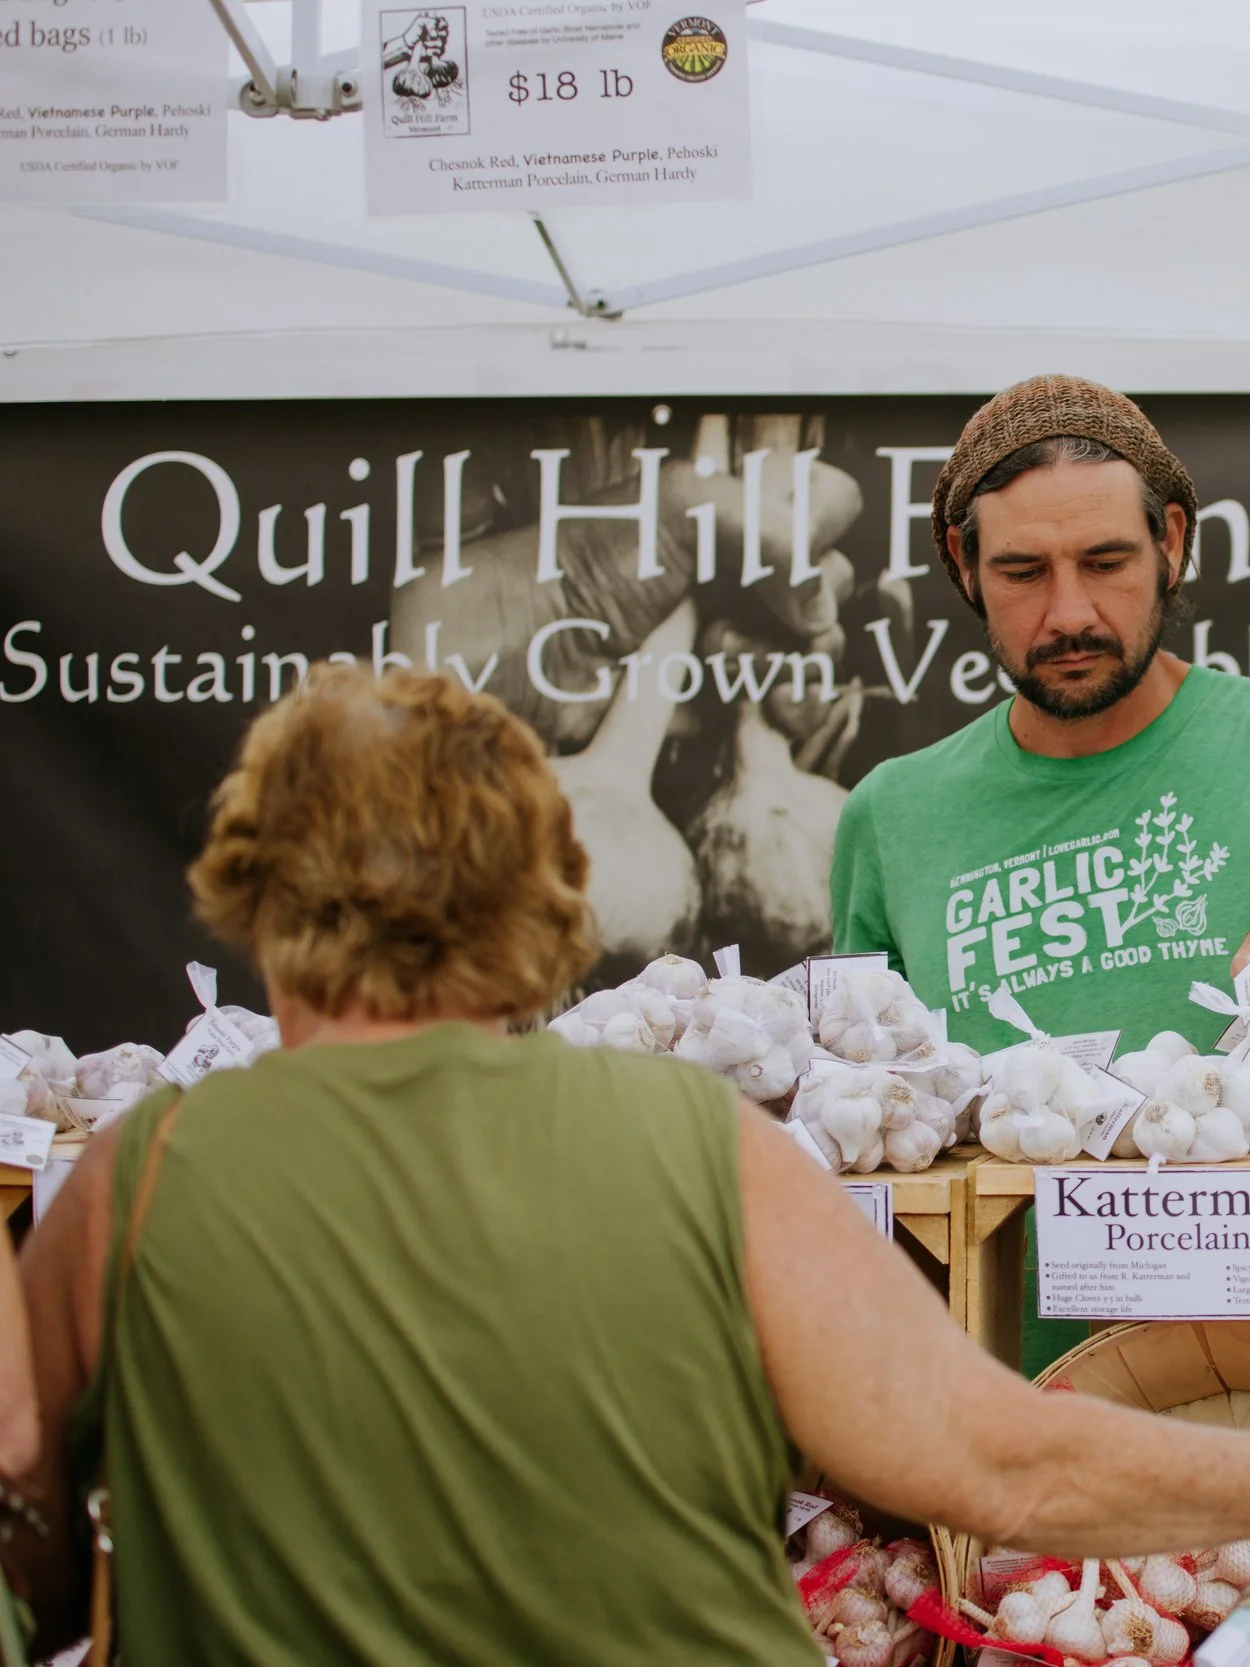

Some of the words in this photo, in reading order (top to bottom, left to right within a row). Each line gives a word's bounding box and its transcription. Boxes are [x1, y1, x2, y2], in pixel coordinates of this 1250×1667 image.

[30, 20, 91, 53] bags
[508, 69, 578, 106] $18
[600, 69, 633, 98] lb
[429, 152, 485, 171] Chesnok
[490, 151, 519, 172] Red,
[523, 146, 606, 166] Vietnamese
[612, 144, 663, 166] Purple,
[668, 141, 717, 159] Pehoski
[453, 172, 523, 190] Katterman
[528, 170, 593, 192] Porcelain,
[596, 167, 650, 184] German
[654, 165, 696, 186] Hardy
[101, 447, 472, 603] Quill
[530, 447, 822, 588] Hill
[526, 617, 839, 704] Grown
[1003, 849, 1042, 869] VERMONT
[946, 846, 1125, 933] GARLIC
[946, 888, 1129, 993] FEST
[952, 981, 993, 1013] IT'S
[1000, 960, 1074, 996] ALWAYS
[1081, 955, 1094, 975] A
[1100, 945, 1152, 972] GOOD
[1157, 937, 1229, 960] THYME
[1071, 1262, 1107, 1271] originally
[1131, 1262, 1167, 1271] Michigan
[1132, 1272, 1174, 1280] Katterman
[1176, 1272, 1191, 1280] and
[1091, 1305, 1117, 1314] storage
